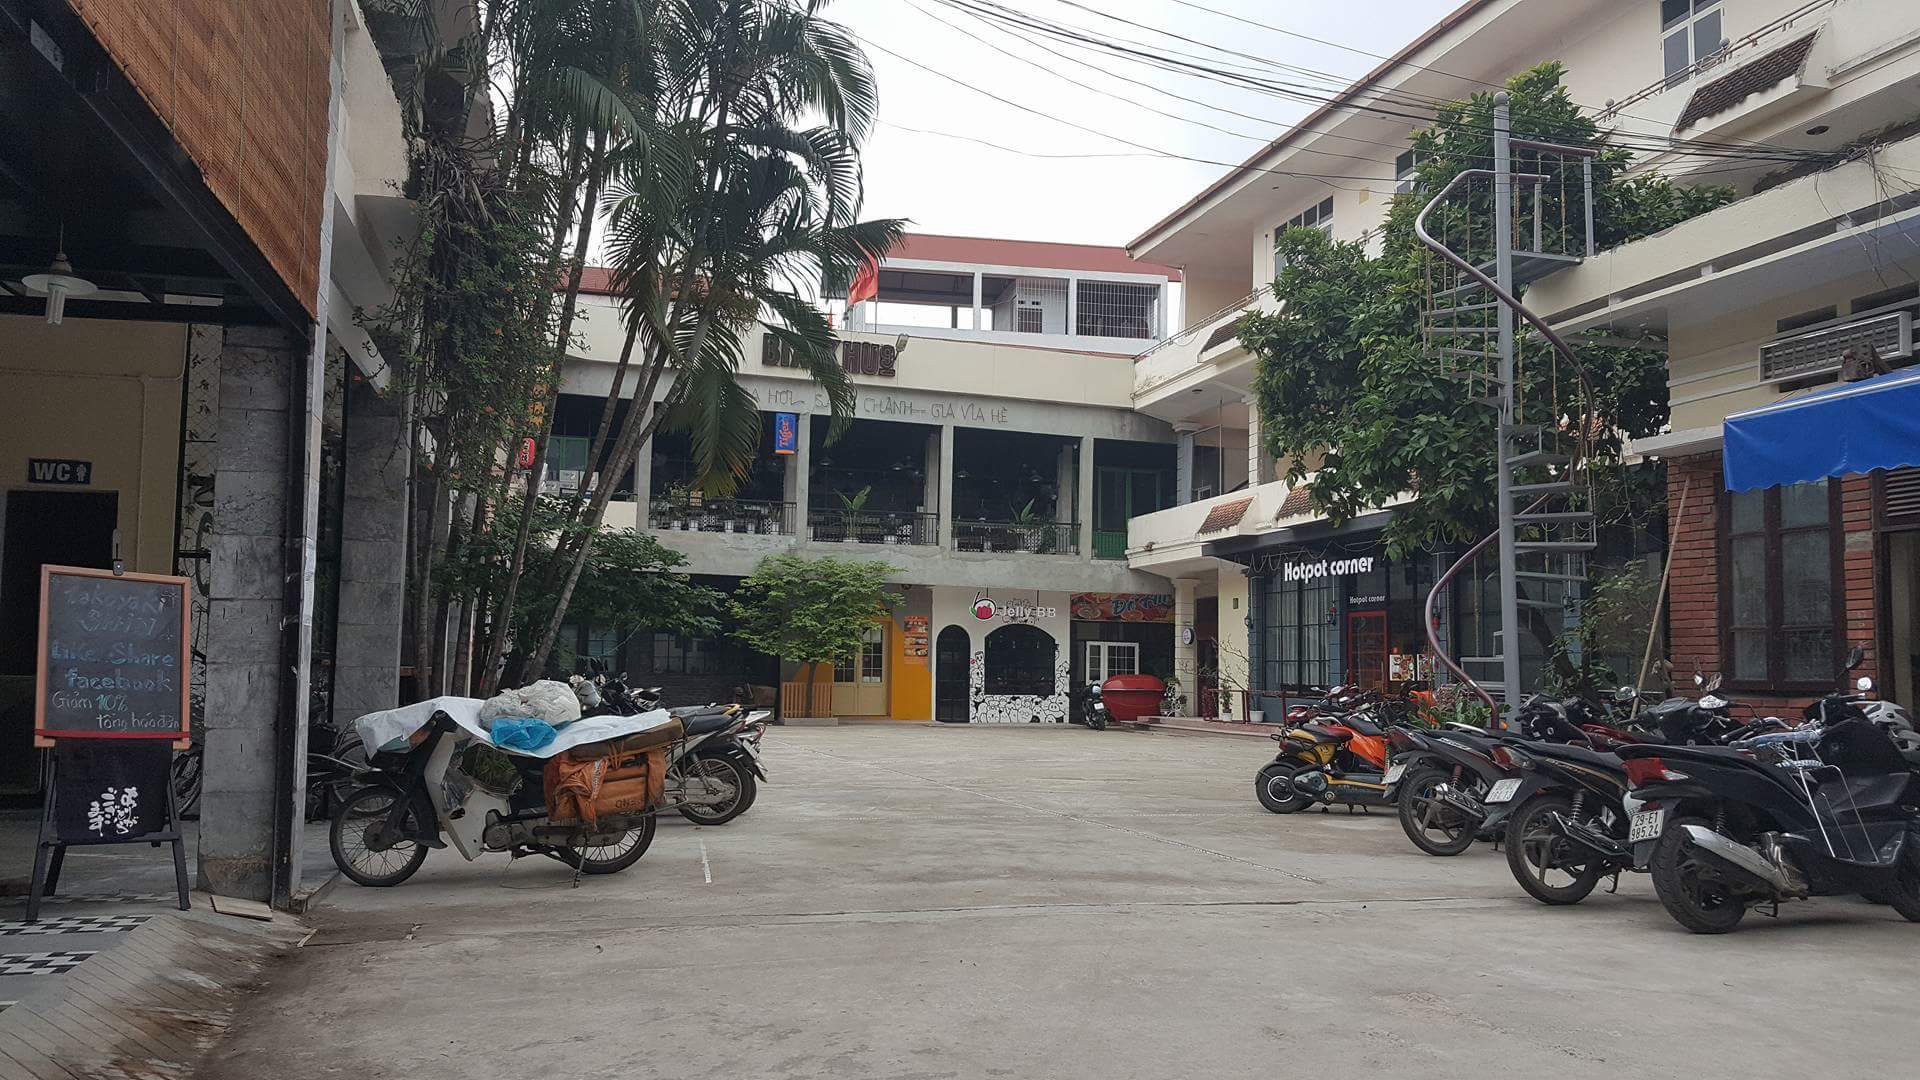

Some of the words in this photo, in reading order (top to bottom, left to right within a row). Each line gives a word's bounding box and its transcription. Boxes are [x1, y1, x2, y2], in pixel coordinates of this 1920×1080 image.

[779, 420, 794, 449] Tiger
[34, 462, 71, 481] WC
[1284, 559, 1327, 584] Hotpot
[1330, 557, 1373, 575] corner
[1349, 596, 1367, 605] Hotpot
[1369, 595, 1385, 603] corner
[1000, 606, 1032, 620] Jelly
[1037, 607, 1056, 618] BB
[96, 694, 128, 712] 10%
[1635, 812, 1658, 827] 29-E1
[1630, 824, 1659, 841] 985.24
